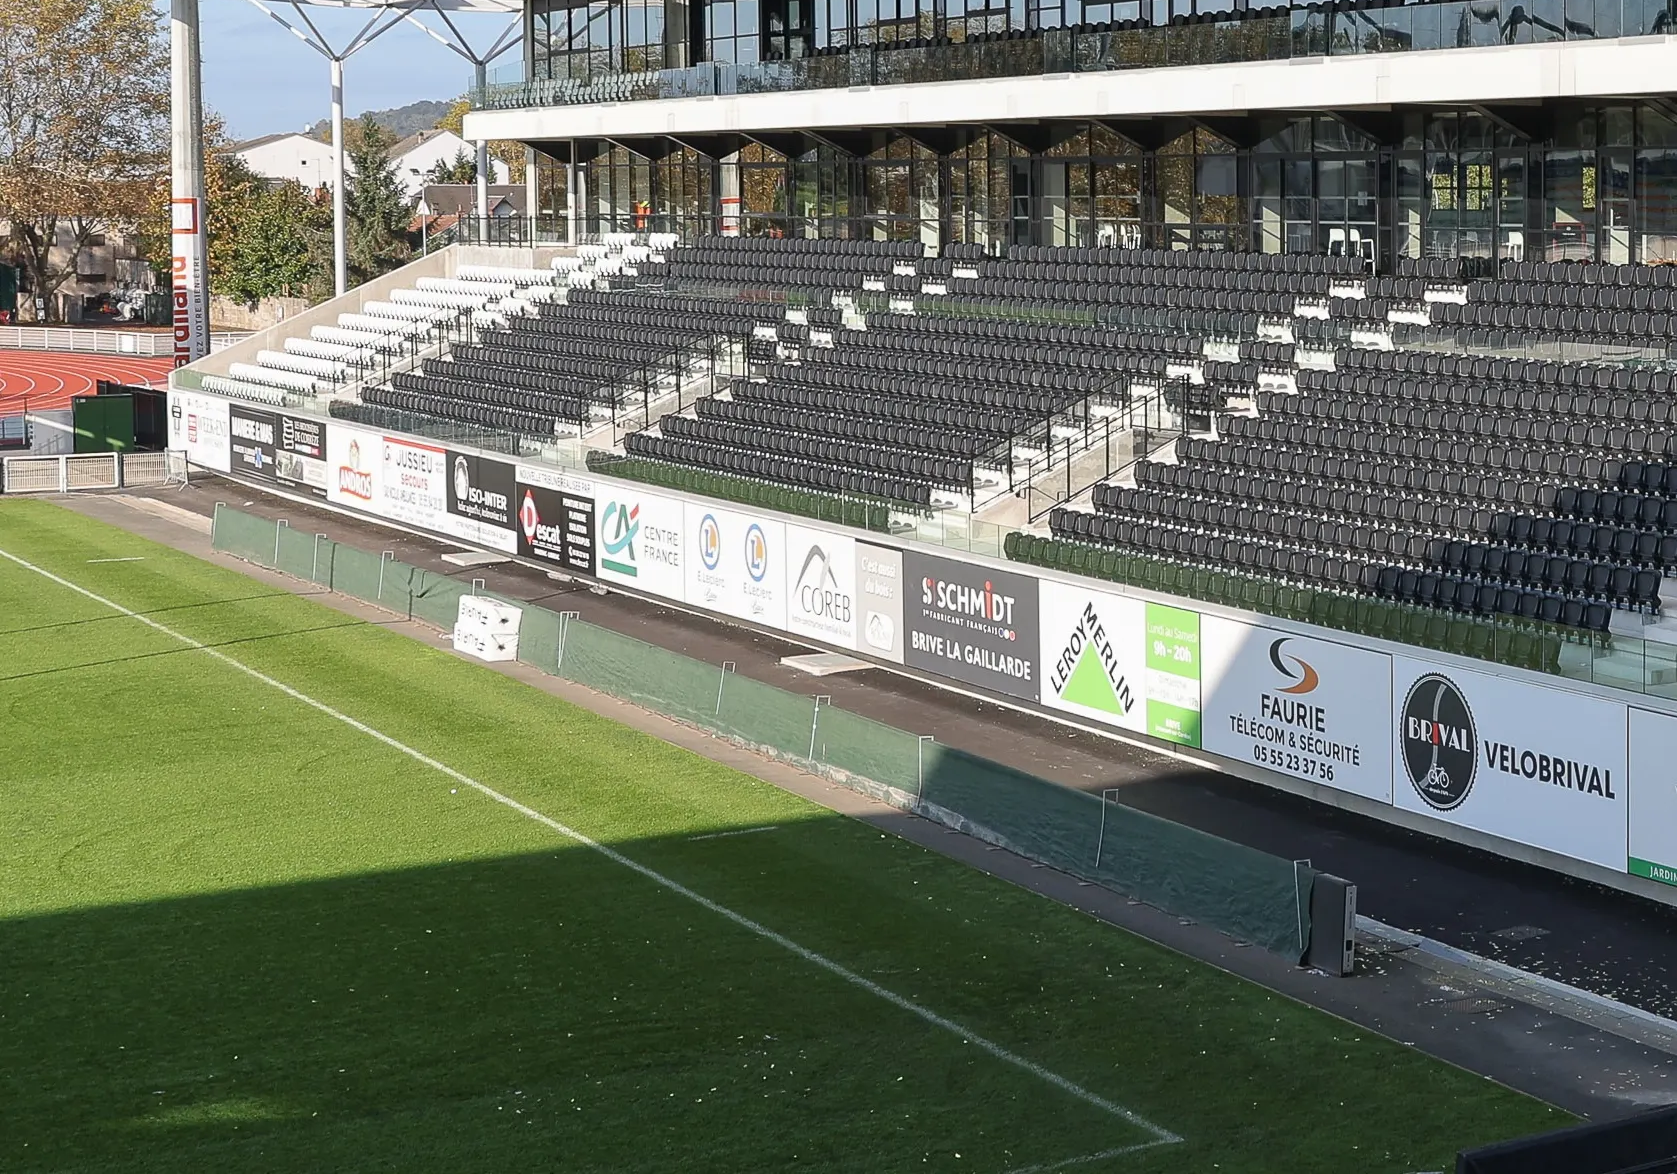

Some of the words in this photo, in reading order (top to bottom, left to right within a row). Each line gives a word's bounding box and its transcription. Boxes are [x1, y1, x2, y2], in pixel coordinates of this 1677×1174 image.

[195, 306, 203, 337] VOTRE
[396, 449, 433, 474] JUSSIEU
[340, 469, 371, 498] ANDROS
[400, 473, 429, 491] secours
[469, 487, 508, 511] ISO-INTER
[644, 526, 679, 546] CENTRE
[644, 546, 679, 567] FRANCE
[801, 584, 851, 623] COREB
[929, 610, 964, 628] FABRICANT
[966, 619, 998, 636] FRANÇAIS
[912, 630, 943, 656] BRIVE
[946, 639, 962, 661] LA
[964, 644, 1031, 681] GAILLARDE
[1050, 617, 1087, 695] LEROY
[1083, 601, 1134, 713] MERLIN
[1153, 640, 1166, 657] 9h
[1173, 645, 1192, 663] 20h
[1261, 693, 1326, 733] FAURIE
[1229, 713, 1285, 745] TÉLÉCOM
[1288, 731, 1296, 748] &
[1299, 733, 1360, 766] SÉCURITÉ
[1408, 716, 1470, 752] BRIVAL
[1254, 744, 1268, 763] 05
[1270, 749, 1283, 767] 55
[1286, 753, 1300, 771] 23
[1303, 757, 1317, 776] 37
[1319, 763, 1334, 781] 56
[1484, 739, 1616, 800] VELOBRIVAL
